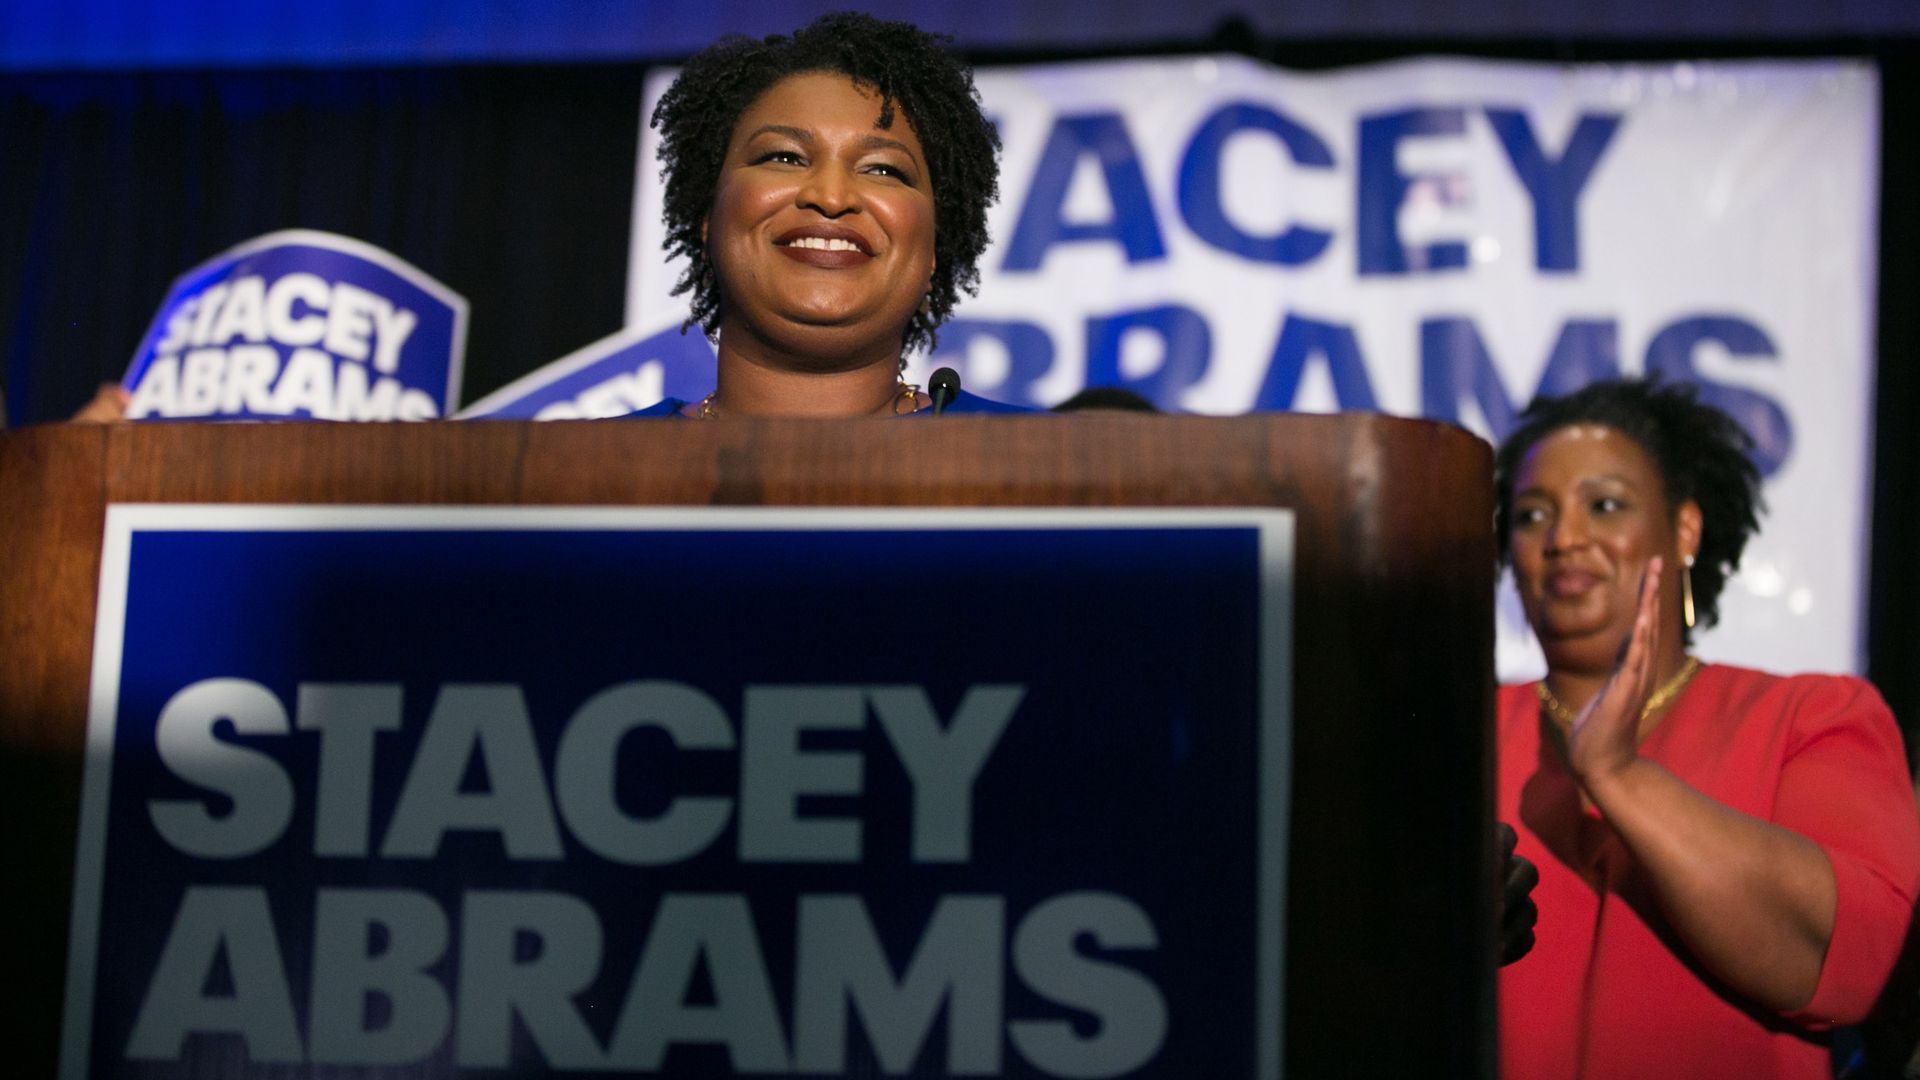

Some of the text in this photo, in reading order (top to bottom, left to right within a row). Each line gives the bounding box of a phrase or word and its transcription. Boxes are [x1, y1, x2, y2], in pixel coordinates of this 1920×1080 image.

[984, 101, 1625, 277] ACEY
[158, 272, 418, 372] STACEY
[148, 676, 1027, 866] STACEY
[124, 886, 1168, 1079] ABRAMS
